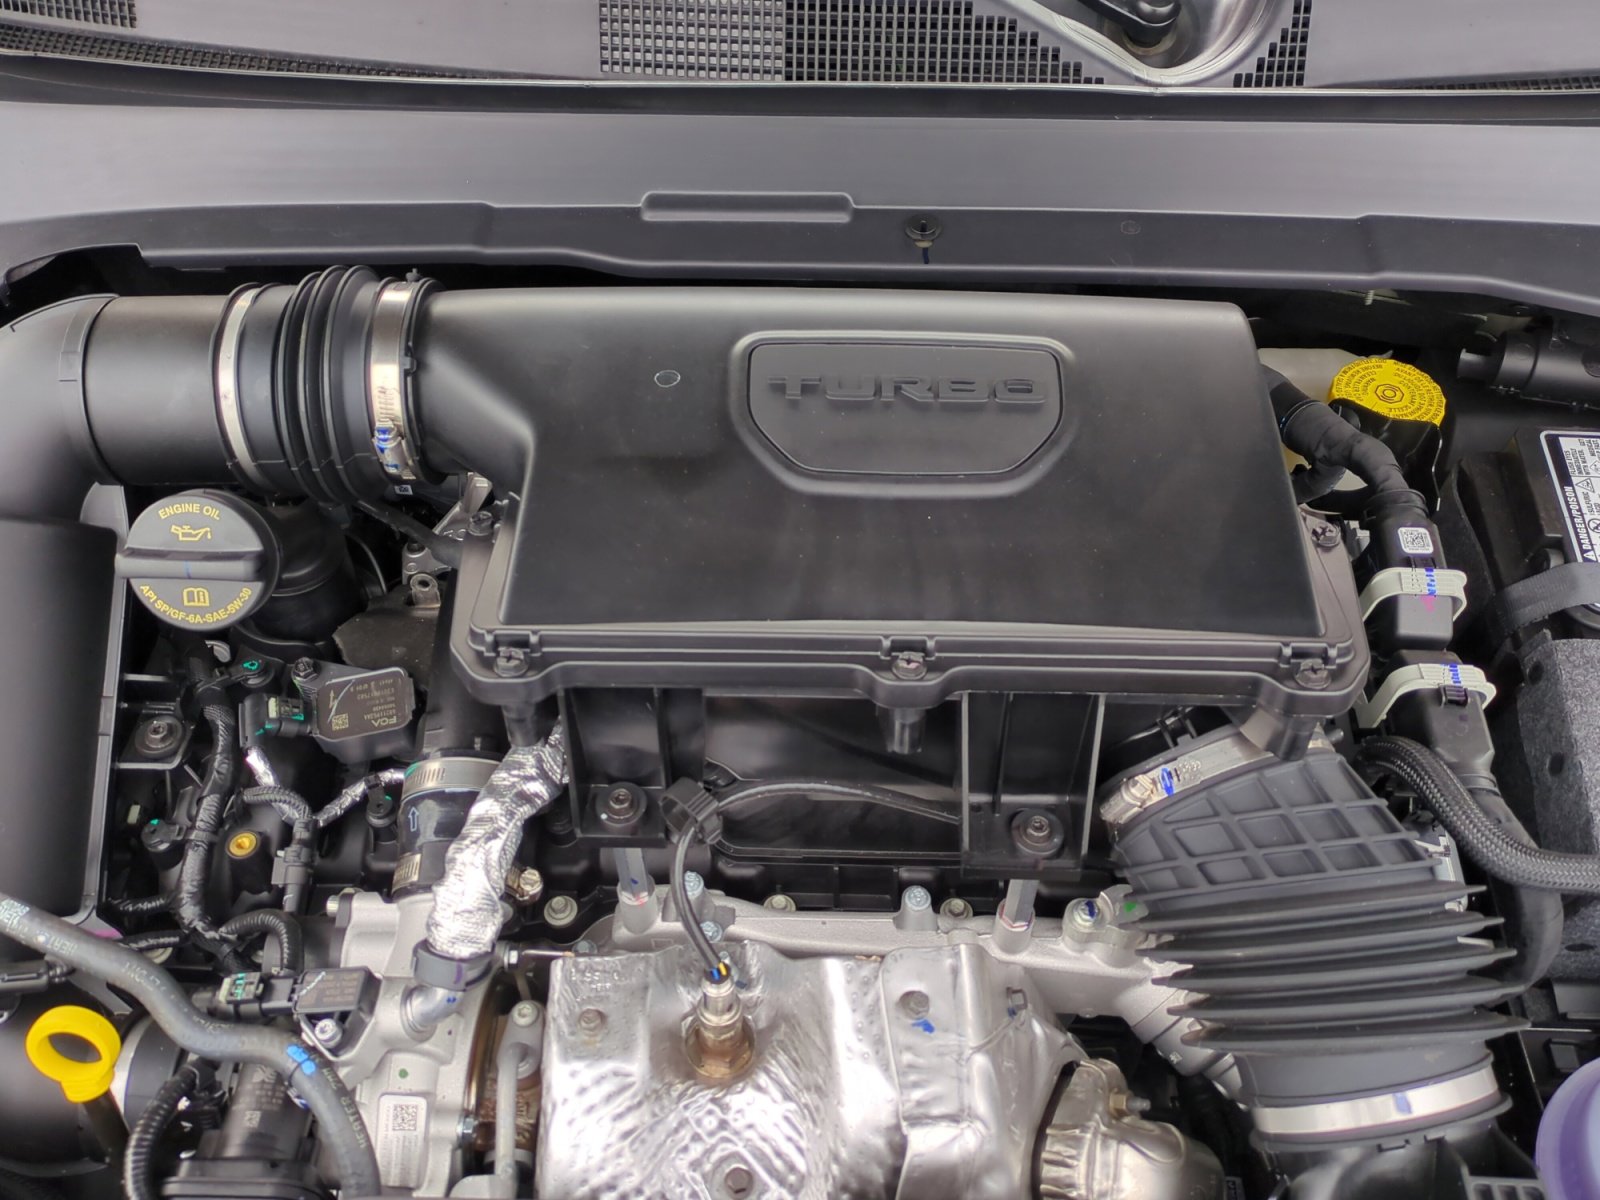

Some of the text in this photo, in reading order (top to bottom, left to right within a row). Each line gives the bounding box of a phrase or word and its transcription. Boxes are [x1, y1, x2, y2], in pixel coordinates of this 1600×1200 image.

[767, 375, 1047, 405] TURBO
[158, 503, 221, 520] ENGINE OIL
[1582, 492, 1594, 512] SULFURIC
[1564, 486, 1592, 549] DANGER/POISON
[140, 585, 157, 603] API
[371, 716, 396, 727] FCA
